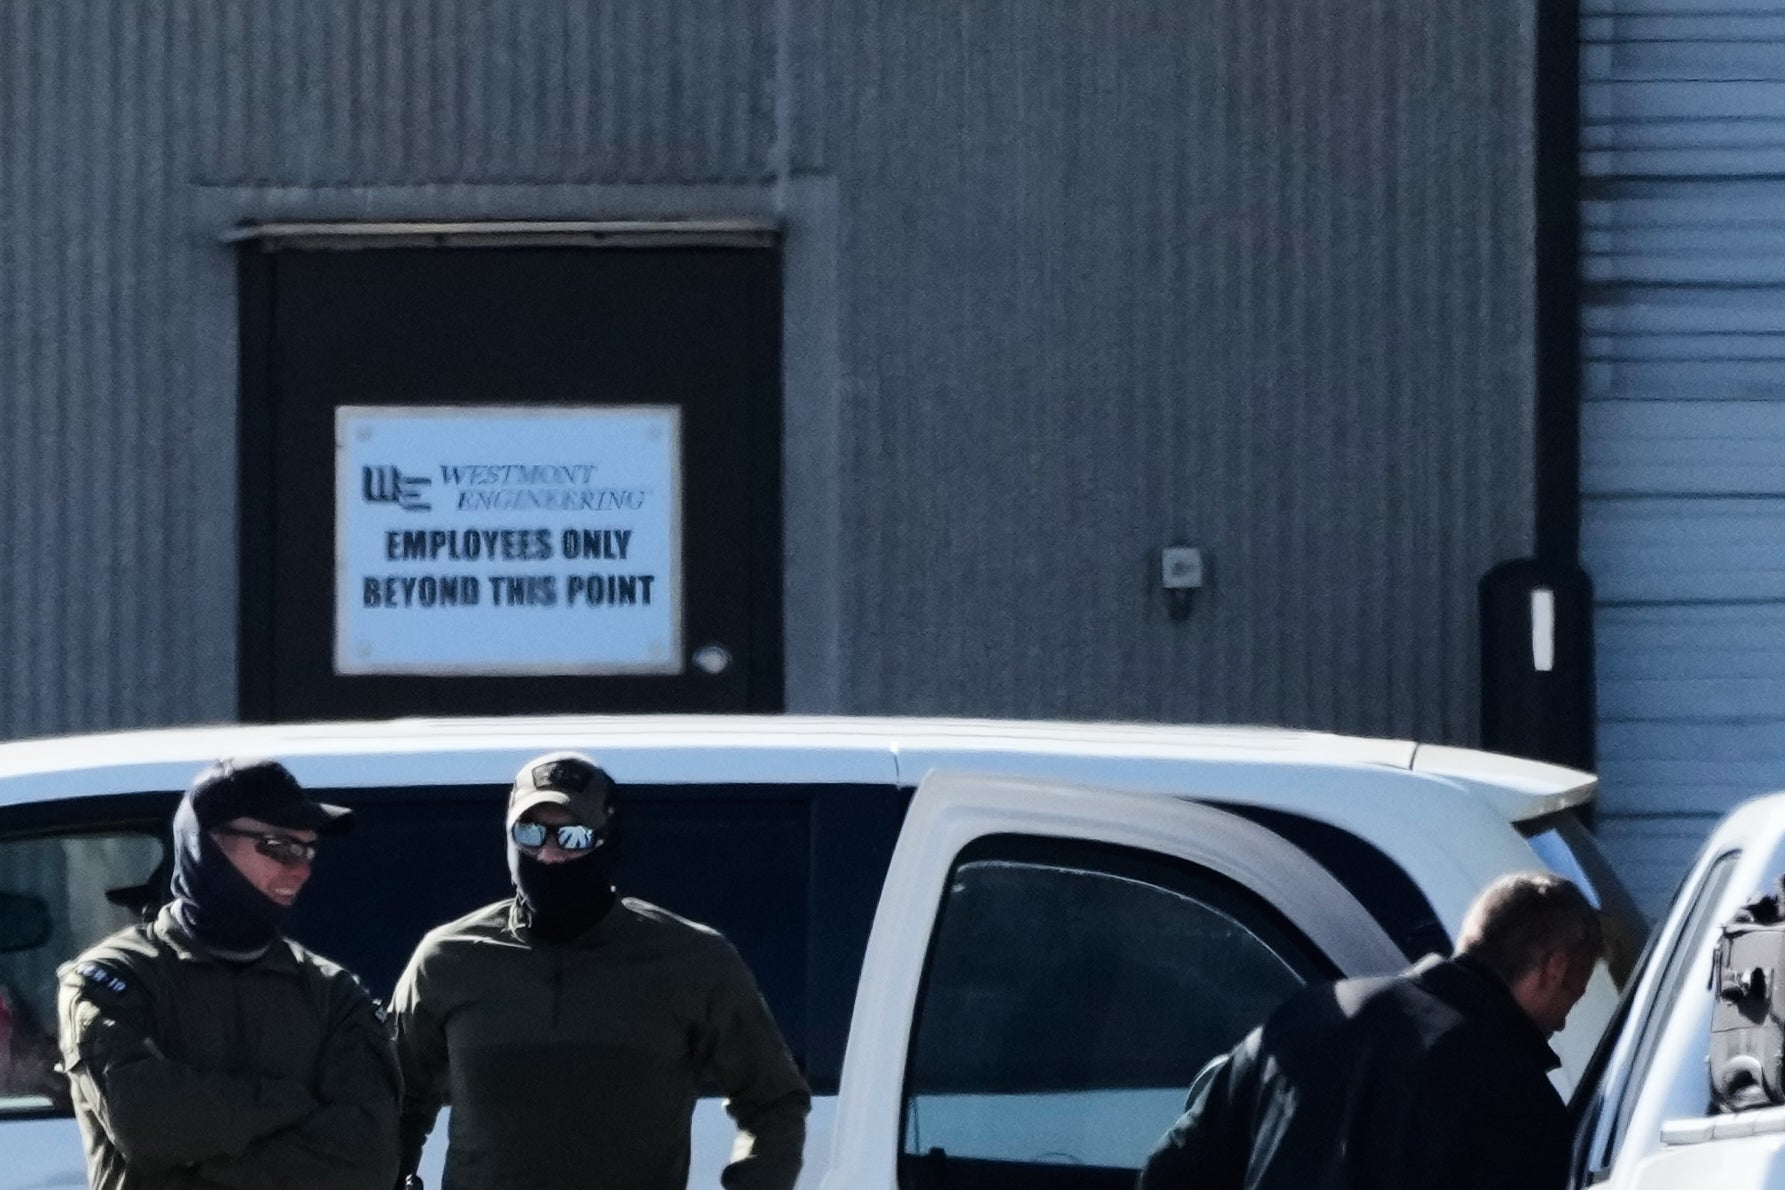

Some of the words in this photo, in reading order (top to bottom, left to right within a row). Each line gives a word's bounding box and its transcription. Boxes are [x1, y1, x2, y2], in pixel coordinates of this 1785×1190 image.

[440, 464, 598, 486] WESTMONT
[456, 489, 646, 511] ENGINEERING
[384, 529, 554, 562] EMPLOYEES
[561, 528, 634, 561] ONLY
[362, 575, 480, 609] BEYOND
[488, 575, 558, 608] THIS
[566, 574, 656, 608] POINT
